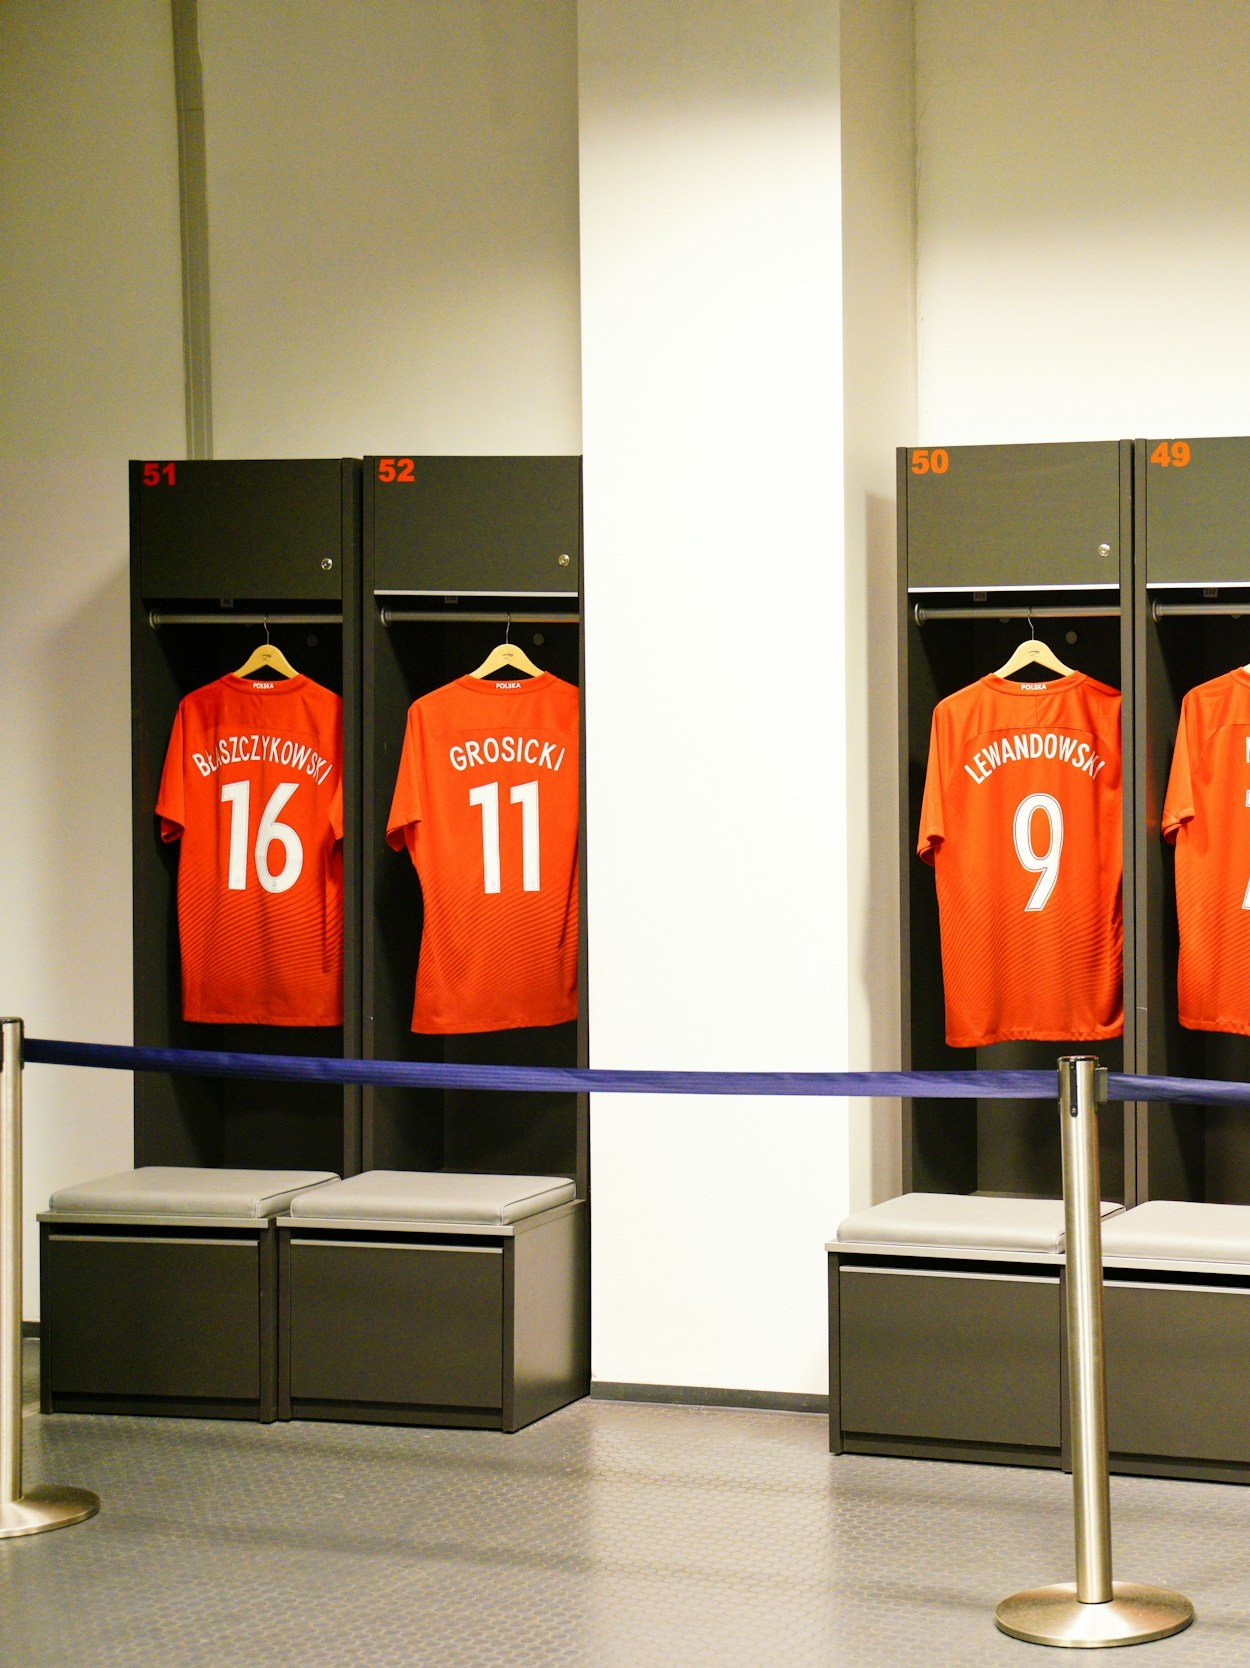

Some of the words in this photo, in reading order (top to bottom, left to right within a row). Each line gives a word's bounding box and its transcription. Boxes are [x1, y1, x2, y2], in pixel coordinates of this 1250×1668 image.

[911, 449, 950, 474] 50
[1149, 441, 1191, 468] 49
[144, 463, 176, 487] 51
[378, 458, 416, 483] 52
[1021, 683, 1047, 691] POLSKA
[449, 736, 566, 772] GROSICKI
[963, 733, 1106, 785] LEWANDOWSKI
[221, 780, 303, 893] 16
[469, 780, 541, 894] 11
[1013, 793, 1063, 911] 9
